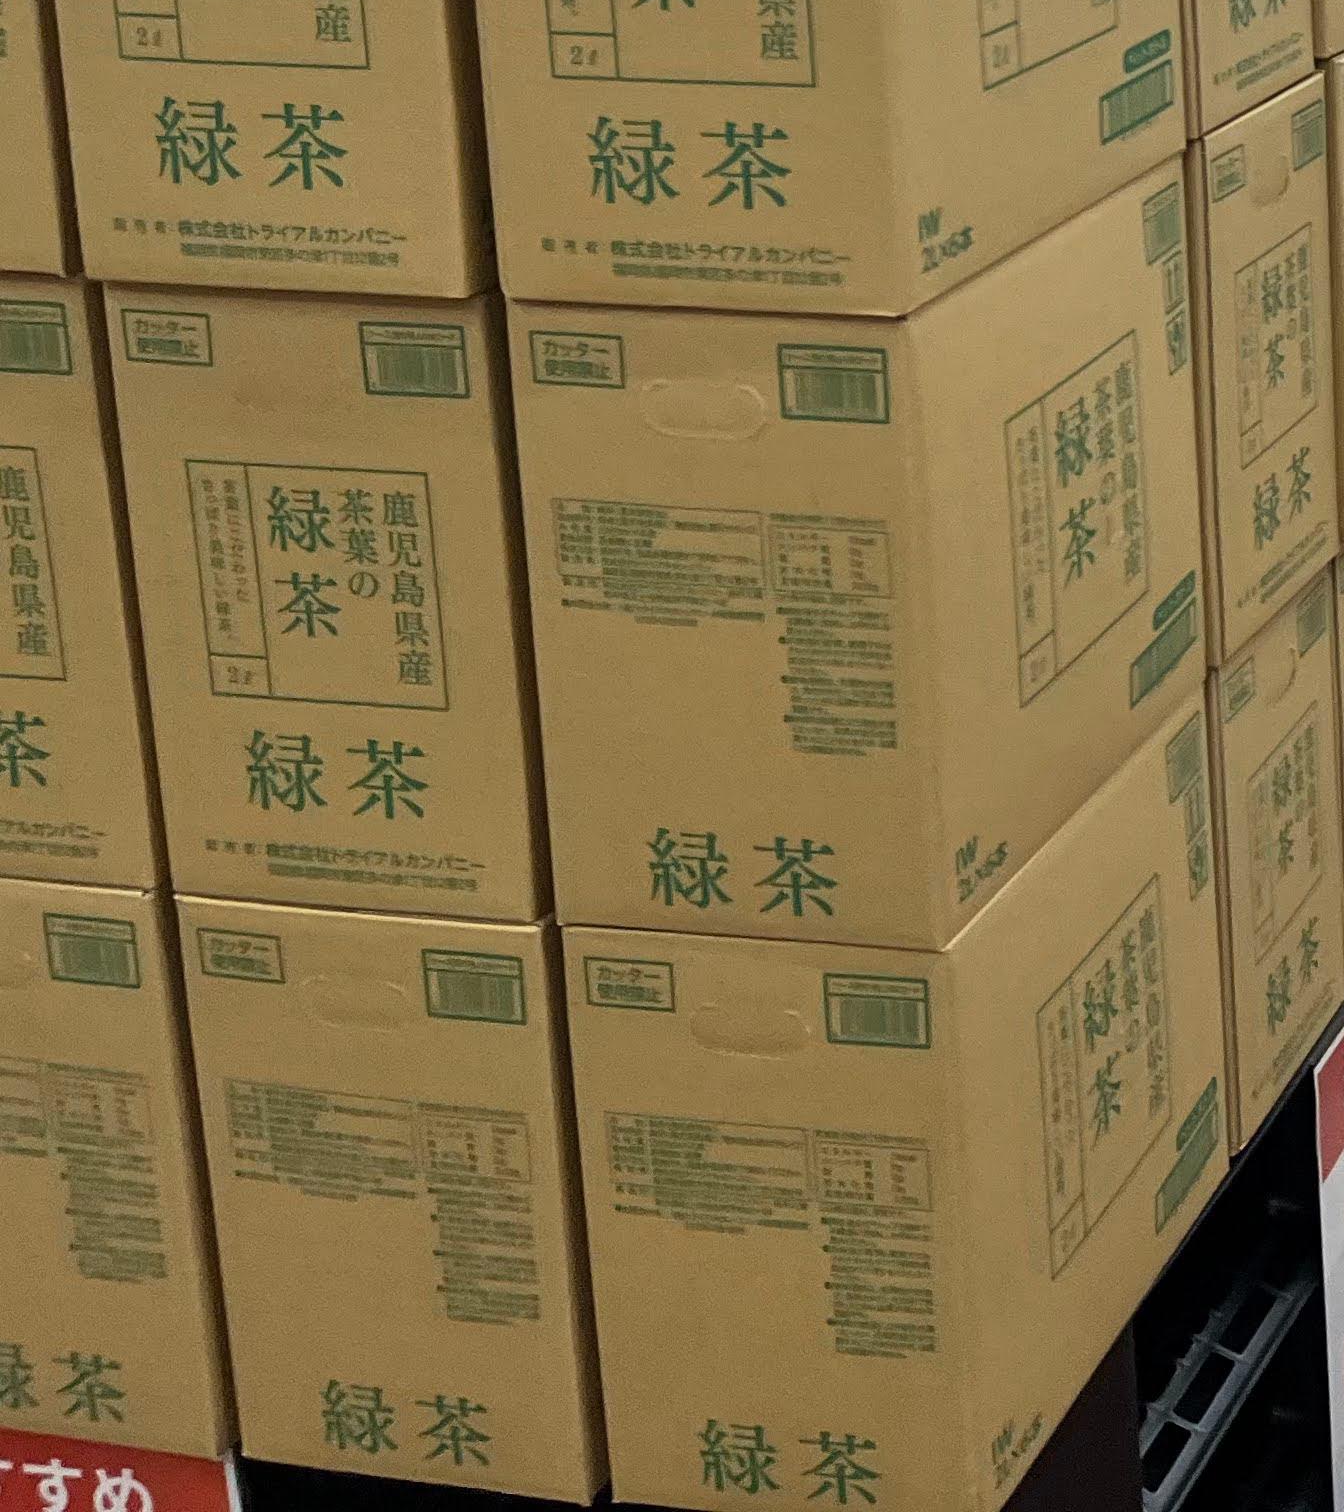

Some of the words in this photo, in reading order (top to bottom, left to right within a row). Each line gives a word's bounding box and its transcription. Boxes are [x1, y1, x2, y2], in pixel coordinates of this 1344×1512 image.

[153, 97, 350, 191] 緑茶
[586, 115, 795, 211] 緑茶
[133, 316, 197, 336] カッター
[541, 339, 610, 358] カッター
[1055, 396, 1097, 589] 緑茶
[267, 486, 343, 639] 緑茶
[336, 489, 380, 599] 茶葉の
[382, 492, 434, 686] 鹿児島県産
[244, 729, 430, 820] 緑茶
[646, 827, 840, 917] 緑茶
[320, 1379, 494, 1469] 緑茶
[698, 1419, 882, 1505] 緑茶
[0, 1458, 154, 1512] すめ
